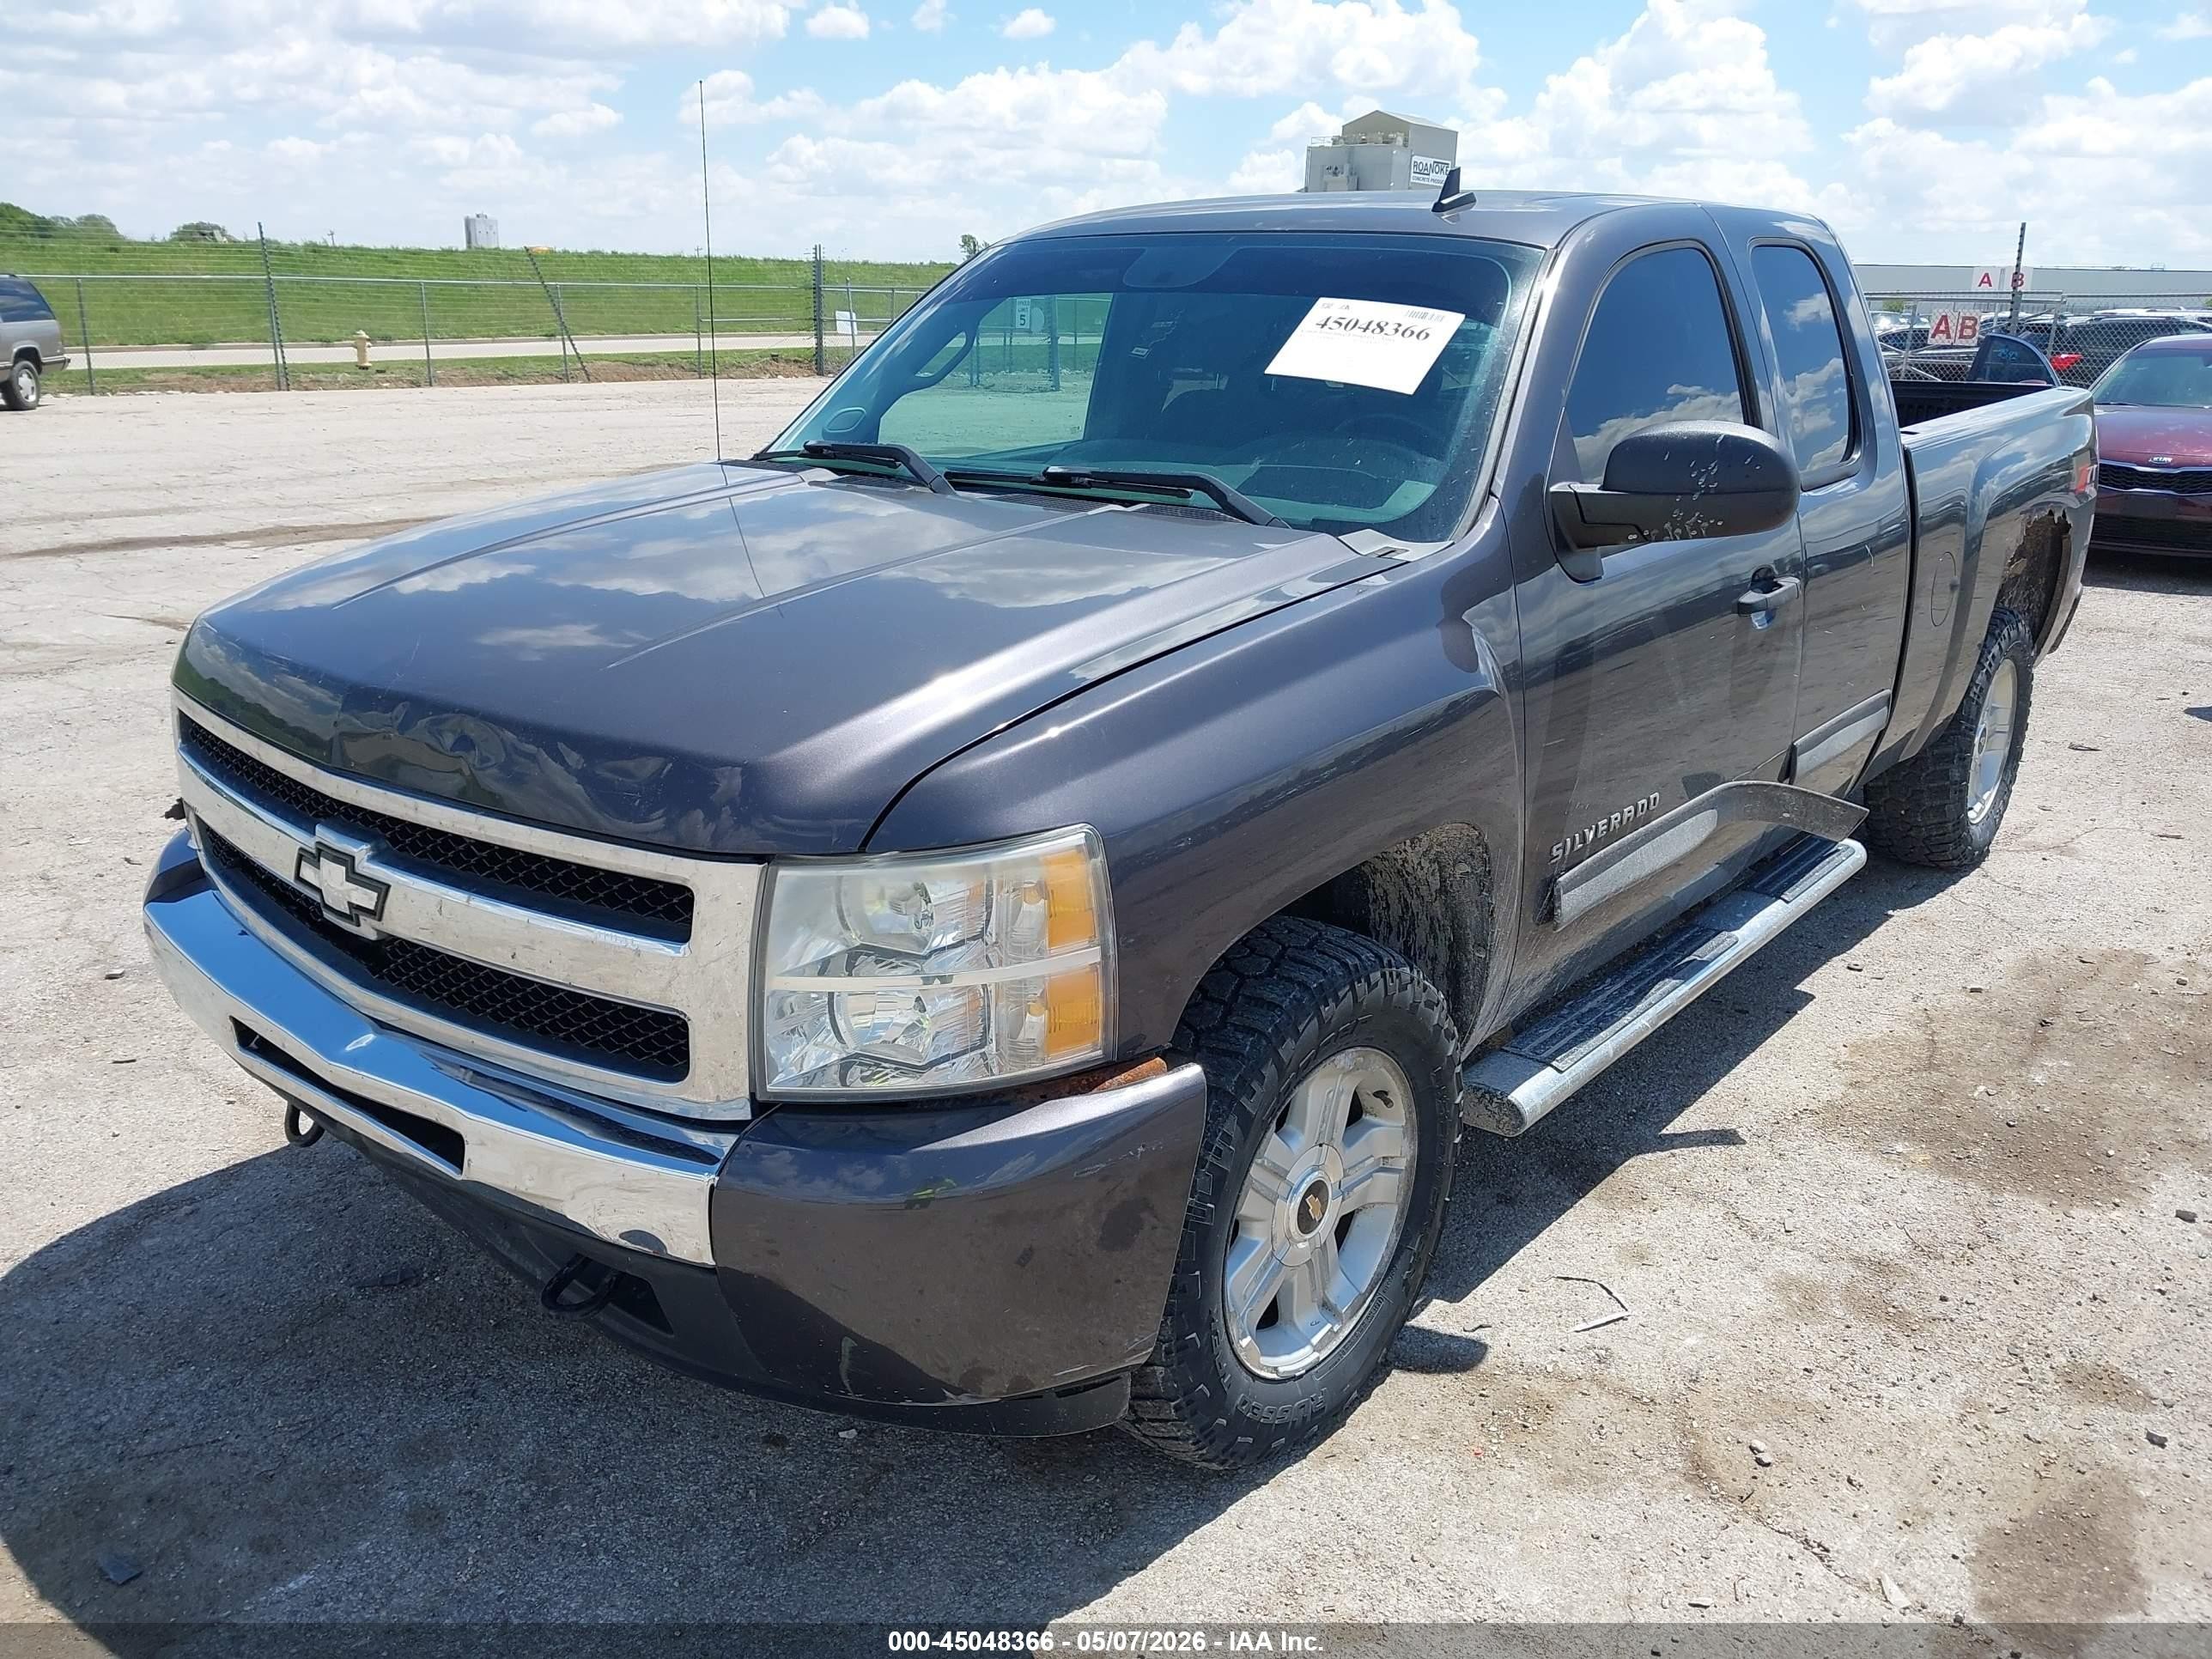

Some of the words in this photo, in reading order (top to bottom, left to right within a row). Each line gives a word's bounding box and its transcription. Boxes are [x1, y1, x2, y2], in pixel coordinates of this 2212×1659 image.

[1413, 161, 1450, 176] ROANOKE
[1978, 272, 1993, 288] A
[2010, 272, 2025, 289] B
[1019, 313, 1026, 326] 5
[1315, 314, 1434, 342] 45048366
[1930, 314, 1952, 339] A
[1957, 315, 1978, 340] B
[1547, 791, 1661, 866] SILVERADO
[1236, 1387, 1328, 1425] RUGGED
